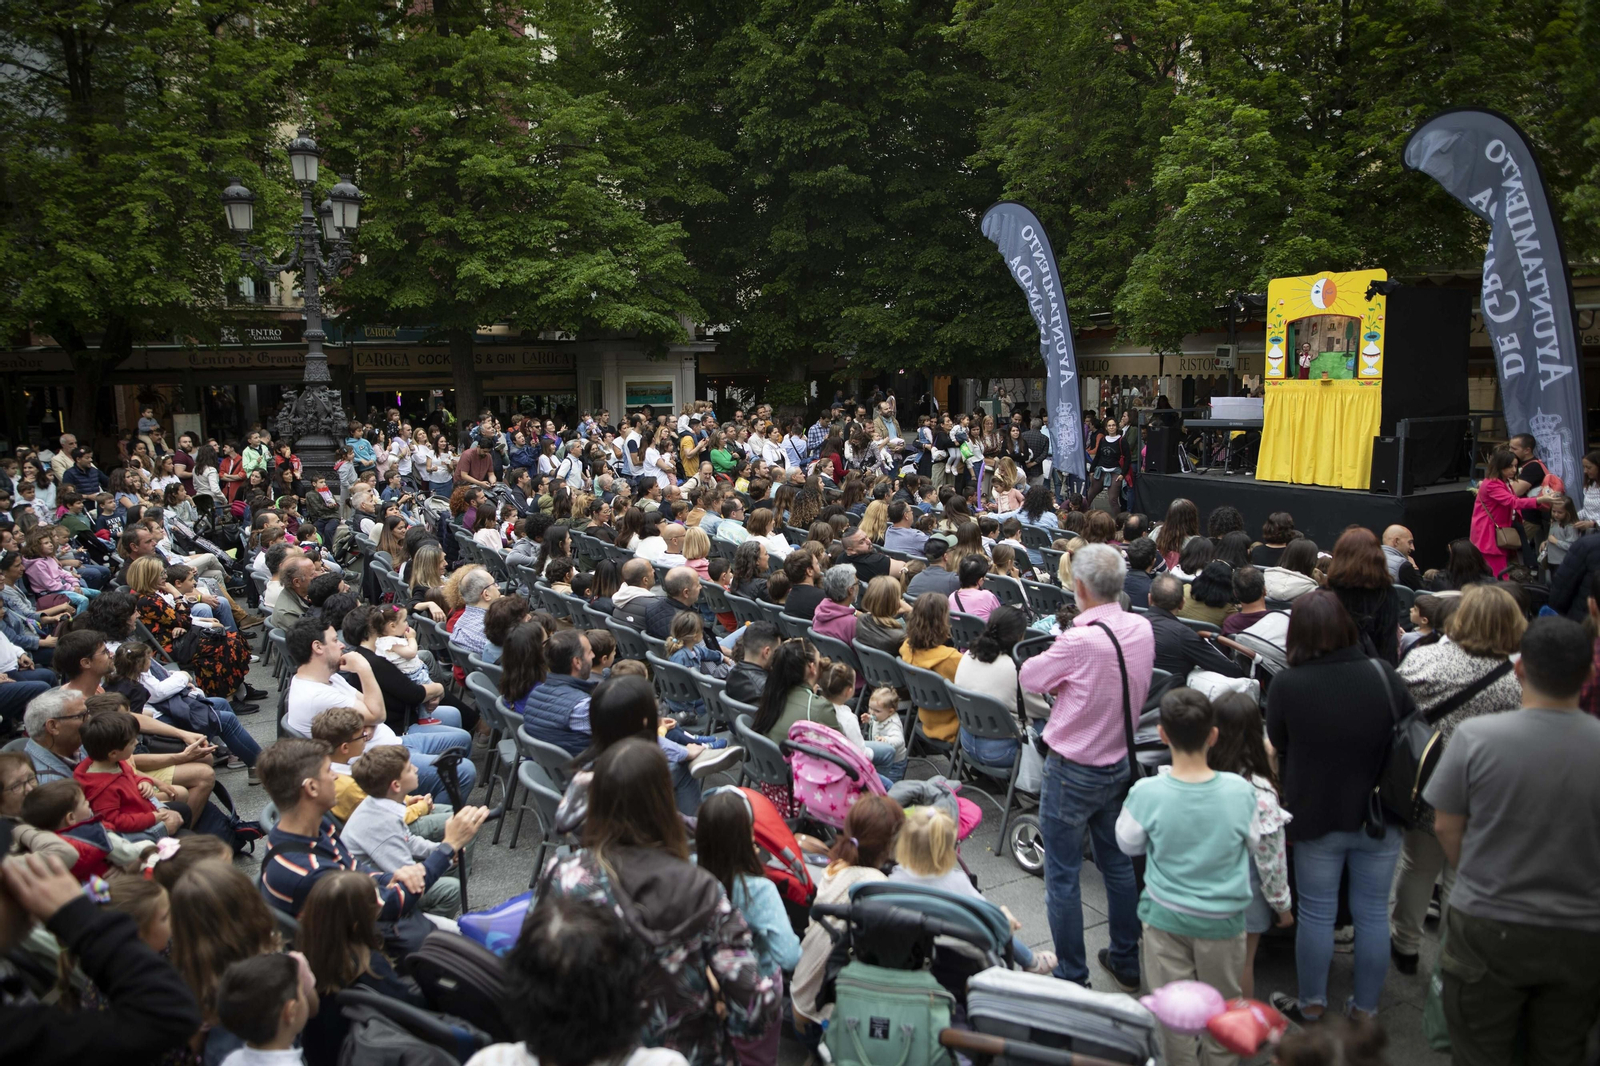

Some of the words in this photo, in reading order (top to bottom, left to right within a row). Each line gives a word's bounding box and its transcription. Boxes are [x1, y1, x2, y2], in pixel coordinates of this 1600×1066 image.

[188, 352, 235, 365] Centro
[238, 352, 251, 364] de
[257, 351, 306, 364] Granad
[356, 352, 410, 366] CAROCA
[485, 353, 493, 364] &
[496, 353, 515, 364] GIN
[522, 351, 570, 365] CAROCA
[1179, 357, 1251, 371] RISTORTE
